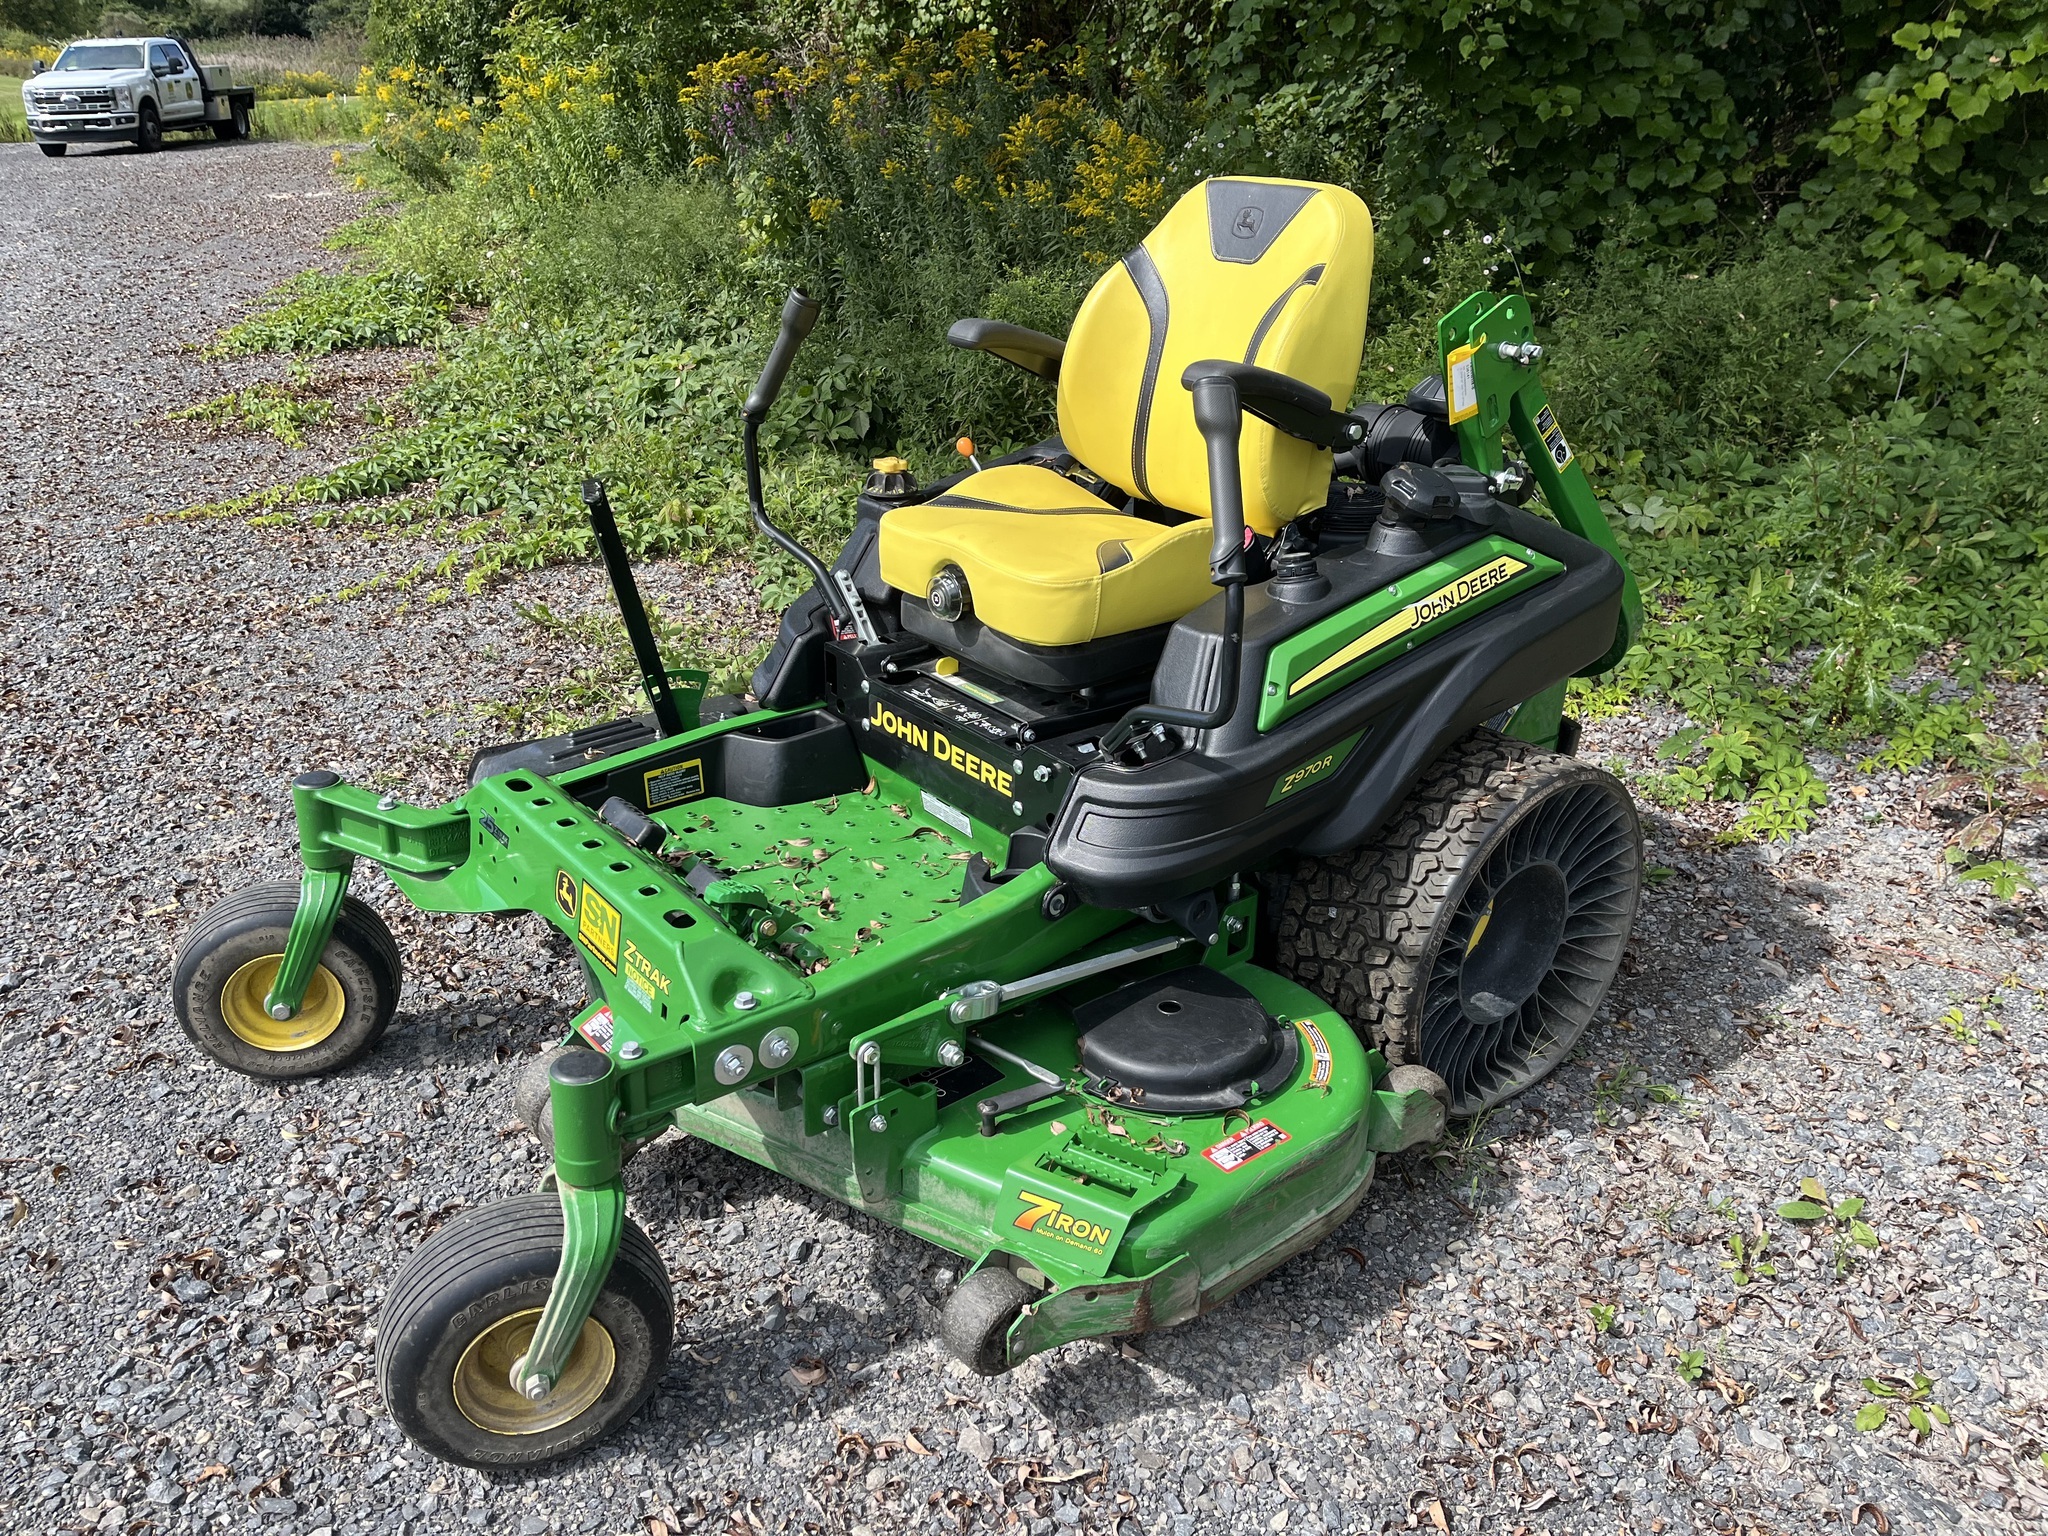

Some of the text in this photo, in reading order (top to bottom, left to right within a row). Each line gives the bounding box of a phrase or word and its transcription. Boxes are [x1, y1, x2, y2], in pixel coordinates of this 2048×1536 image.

[1411, 563, 1508, 627] JOHN DEERE
[870, 701, 1013, 798] JOHN DEERE
[1281, 755, 1333, 794] Z970R
[582, 920, 615, 956] PARTNERS
[335, 950, 374, 1024] CARLISLE
[623, 939, 672, 995] ZTRAK
[627, 966, 654, 996] NOTICE
[192, 969, 227, 1051] RELIANCE
[1036, 1227, 1055, 1239] Mulch
[1065, 1237, 1093, 1252] Demand
[452, 1279, 550, 1329] CARLIS
[468, 1421, 601, 1463] RELIANCE
